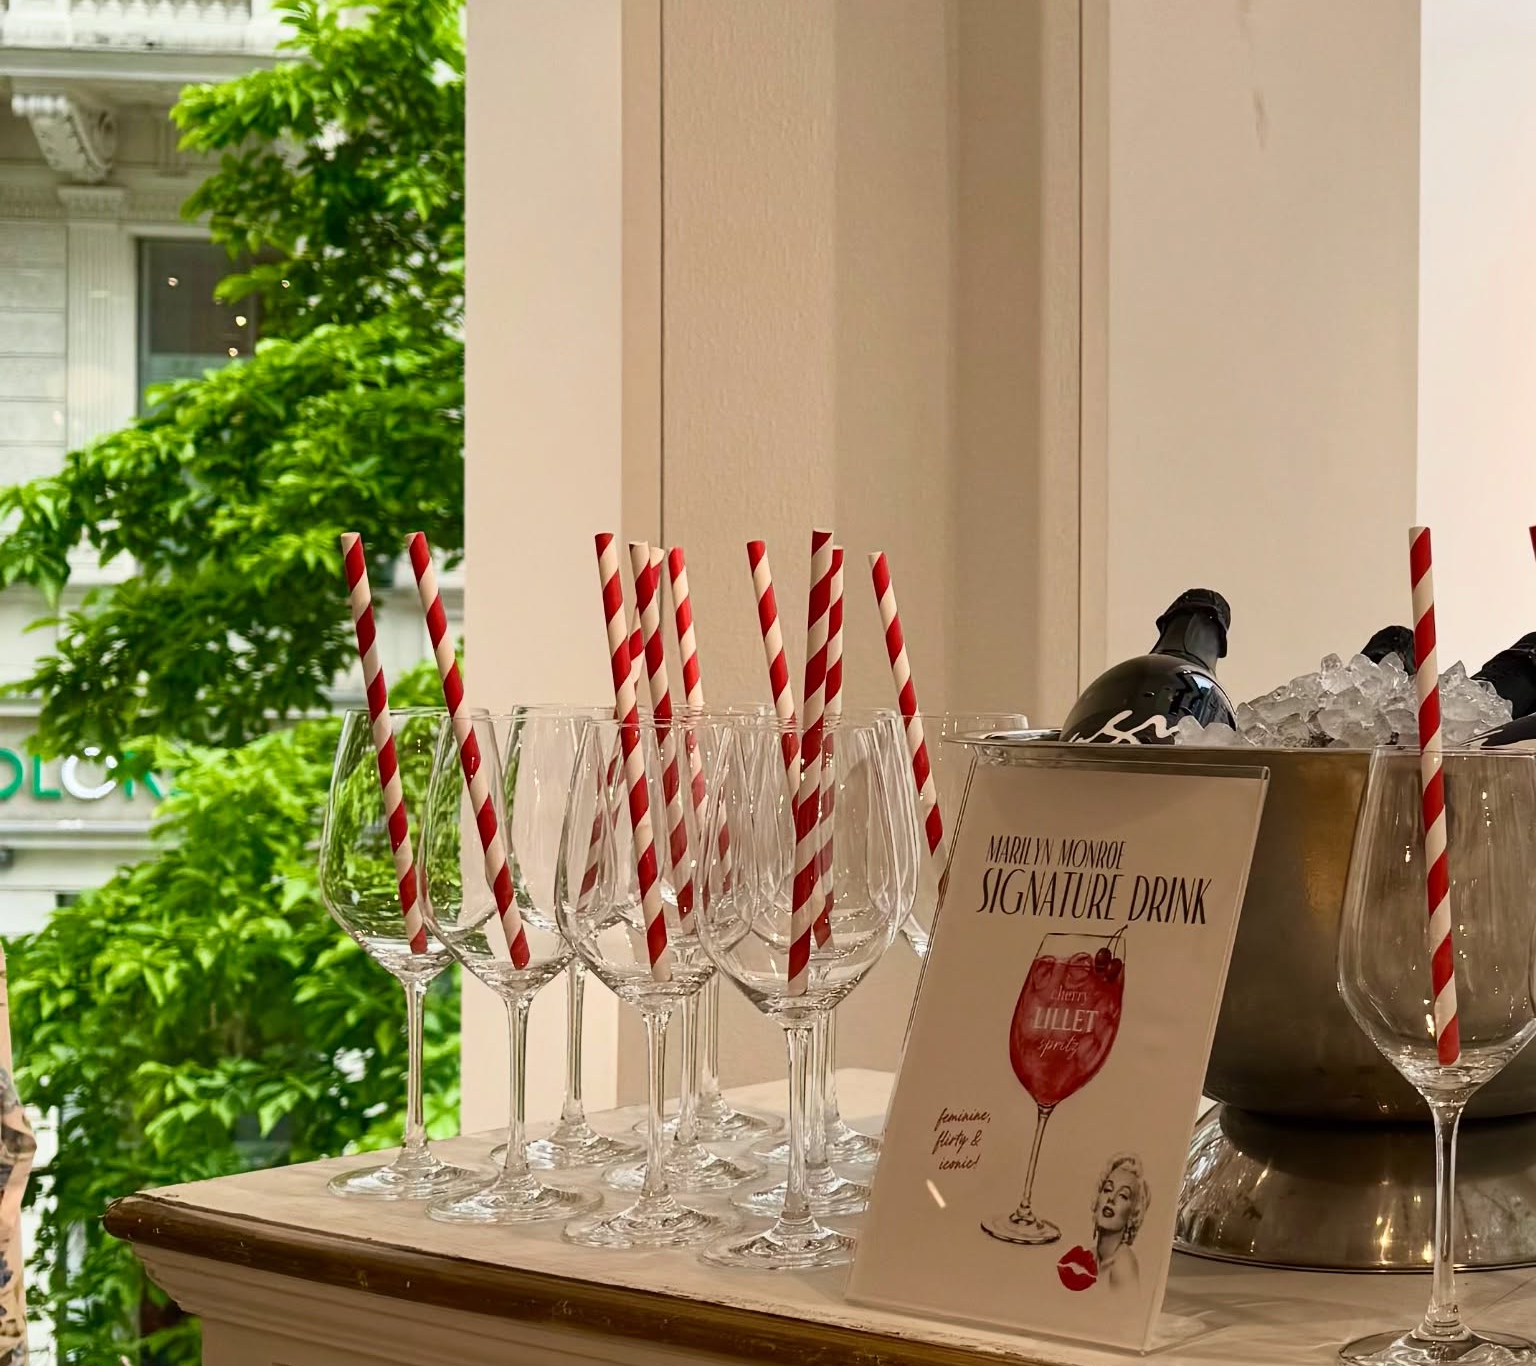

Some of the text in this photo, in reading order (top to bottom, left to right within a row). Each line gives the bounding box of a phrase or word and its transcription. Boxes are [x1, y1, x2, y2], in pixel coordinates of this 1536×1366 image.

[985, 835, 1127, 869] MARILYN MONROE
[976, 868, 1212, 925] SIGNATURE DRINK
[1050, 985, 1088, 1007] cherry
[1032, 1007, 1099, 1033] LILLET
[1037, 1035, 1080, 1059] spritz
[934, 1108, 990, 1131] feminine,
[932, 1130, 982, 1155] flirty &
